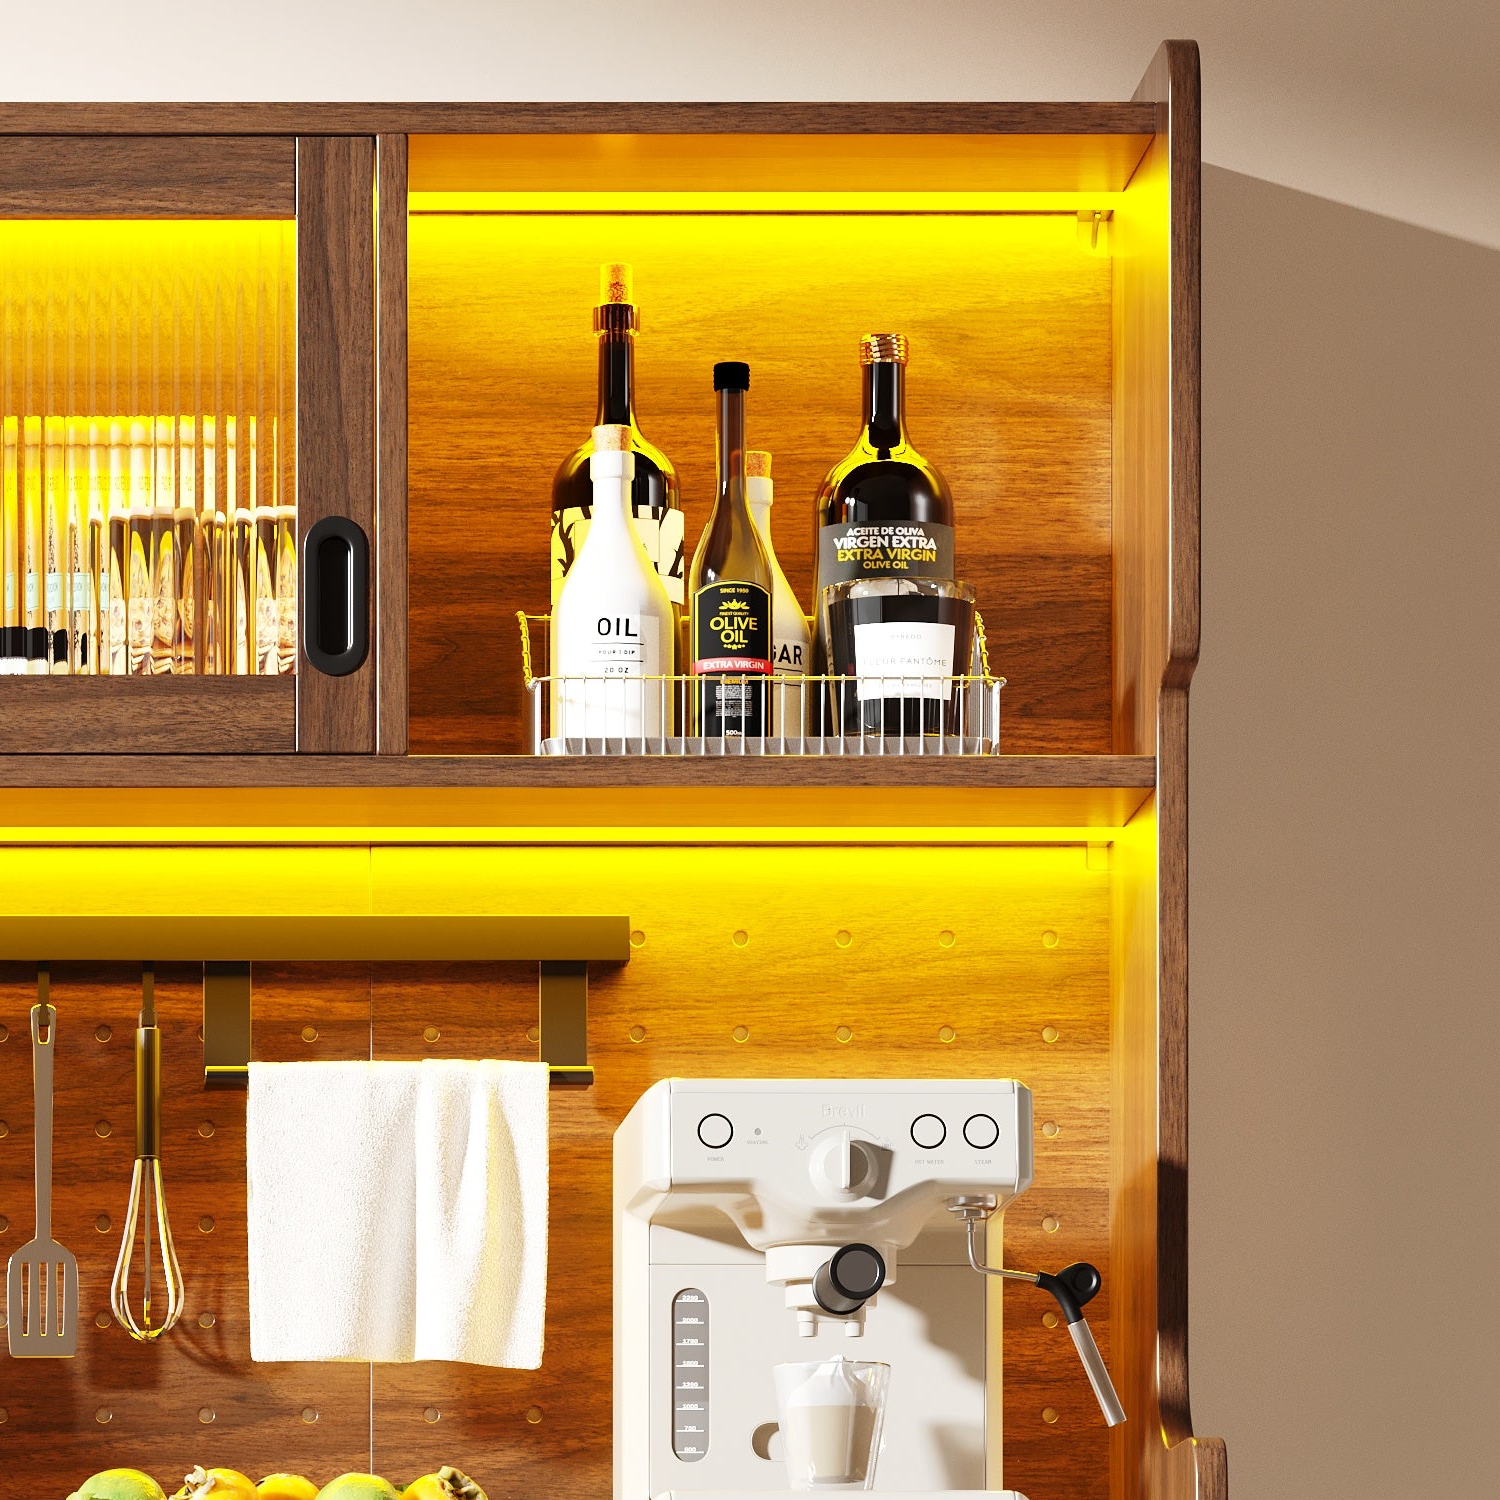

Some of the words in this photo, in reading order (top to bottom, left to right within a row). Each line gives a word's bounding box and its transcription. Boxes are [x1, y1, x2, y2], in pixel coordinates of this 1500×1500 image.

[846, 527, 880, 537] ACEITE
[880, 526, 895, 536] DE
[895, 527, 925, 537] OLIVA
[833, 536, 890, 550] VIRGEN
[891, 535, 937, 551] EXTRA
[837, 548, 884, 562] EXTRA
[886, 548, 937, 562] VIRGIN
[862, 560, 891, 570] OLIVE
[892, 560, 909, 570] OIL
[597, 617, 638, 637] OIL
[709, 616, 758, 631] OLIVE
[720, 629, 749, 643] OIL
[702, 660, 733, 670] EXTRA
[733, 660, 765, 670] VIRGIN
[899, 656, 948, 667] FANTÔME
